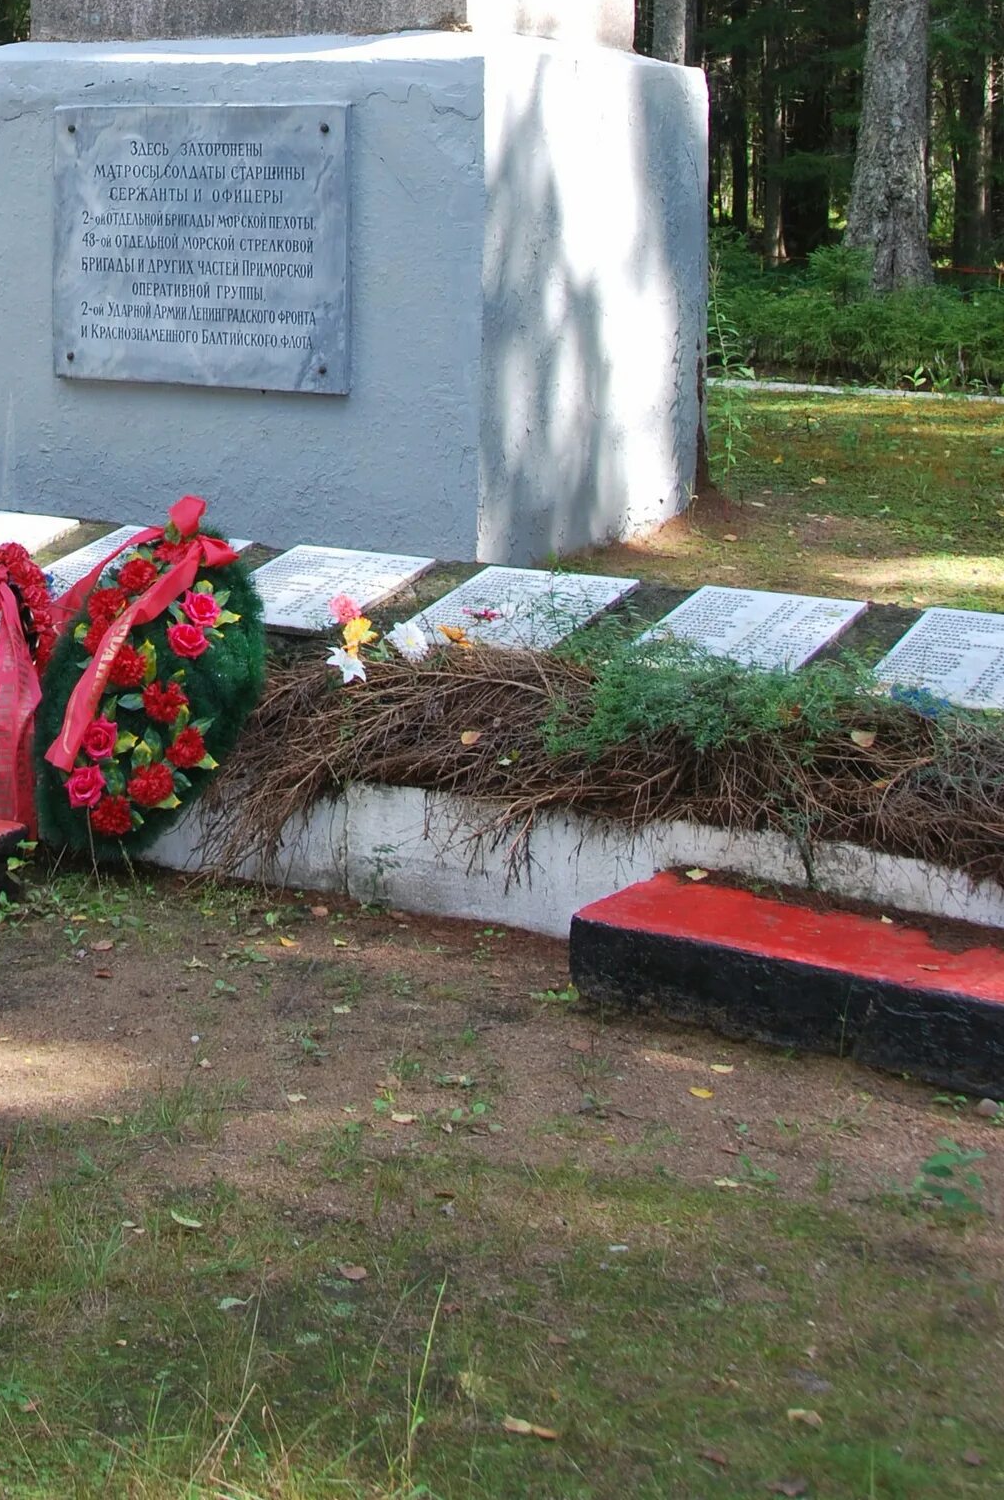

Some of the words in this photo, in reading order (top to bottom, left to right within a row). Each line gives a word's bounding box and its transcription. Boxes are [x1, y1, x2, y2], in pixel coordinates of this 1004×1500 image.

[130, 140, 169, 156] ЗДЕСЬ
[180, 142, 263, 157] ЗАХОРОНЕНЫ
[93, 164, 160, 180] МАТРОСЫ
[164, 164, 226, 180] СОЛДАТЫ
[231, 165, 305, 181] СТАРШИНЫ
[109, 186, 188, 201] СЕРЖАНТЫ
[194, 188, 202, 202] И
[212, 188, 283, 204] ОФИЦЕРЫ
[165, 213, 215, 229] БРИГАДЫ
[216, 212, 267, 229] МОРСКОЙ
[115, 233, 178, 249] ОТДЕЛЬНОЙ
[182, 234, 235, 251] МОРСКОЙ
[239, 237, 314, 254] СТРЕЛКОВОЙ
[81, 256, 135, 274] БРИГАДЫ
[138, 258, 145, 272] И
[148, 259, 194, 275] ДРУГИХ
[198, 258, 239, 276] ЧАСТЕЙ
[132, 281, 210, 299] ОПЕРАТИВНОЙ
